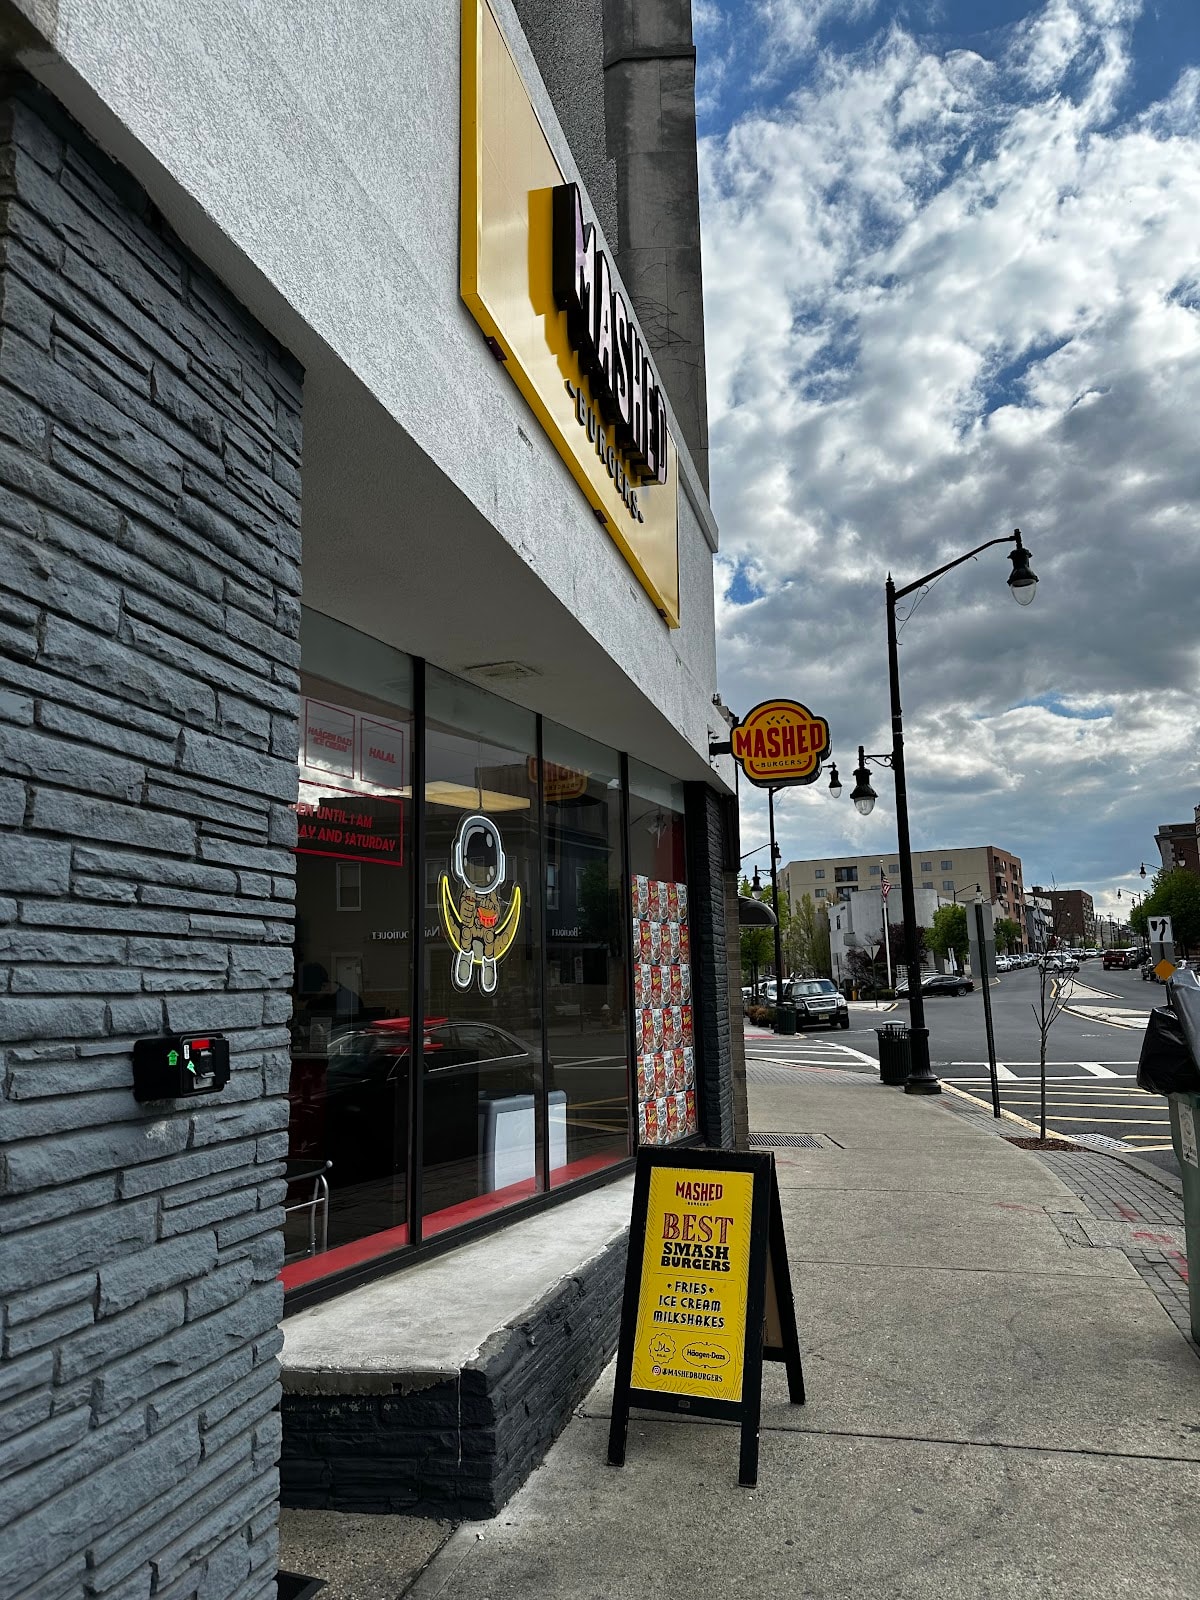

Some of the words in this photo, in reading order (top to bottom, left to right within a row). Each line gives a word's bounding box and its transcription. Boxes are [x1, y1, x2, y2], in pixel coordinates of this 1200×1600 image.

[554, 182, 667, 486] MASHED
[575, 387, 639, 519] BURGERS
[735, 723, 824, 758] MASHED
[369, 747, 396, 763] HALAL
[760, 758, 802, 768] BURGERS
[316, 806, 347, 824] UNTIL
[356, 815, 373, 828] AM
[317, 827, 342, 844] AND
[344, 832, 396, 851] SATURDAY
[675, 1181, 723, 1202] MASHED
[662, 1212, 734, 1244] BEST
[663, 1241, 730, 1260] SMASH
[660, 1255, 731, 1272] BURGERS
[674, 1281, 708, 1295] FRIES
[659, 1294, 677, 1308] ICE
[680, 1297, 722, 1312] CREAM
[653, 1310, 725, 1329] MILKSHAKES
